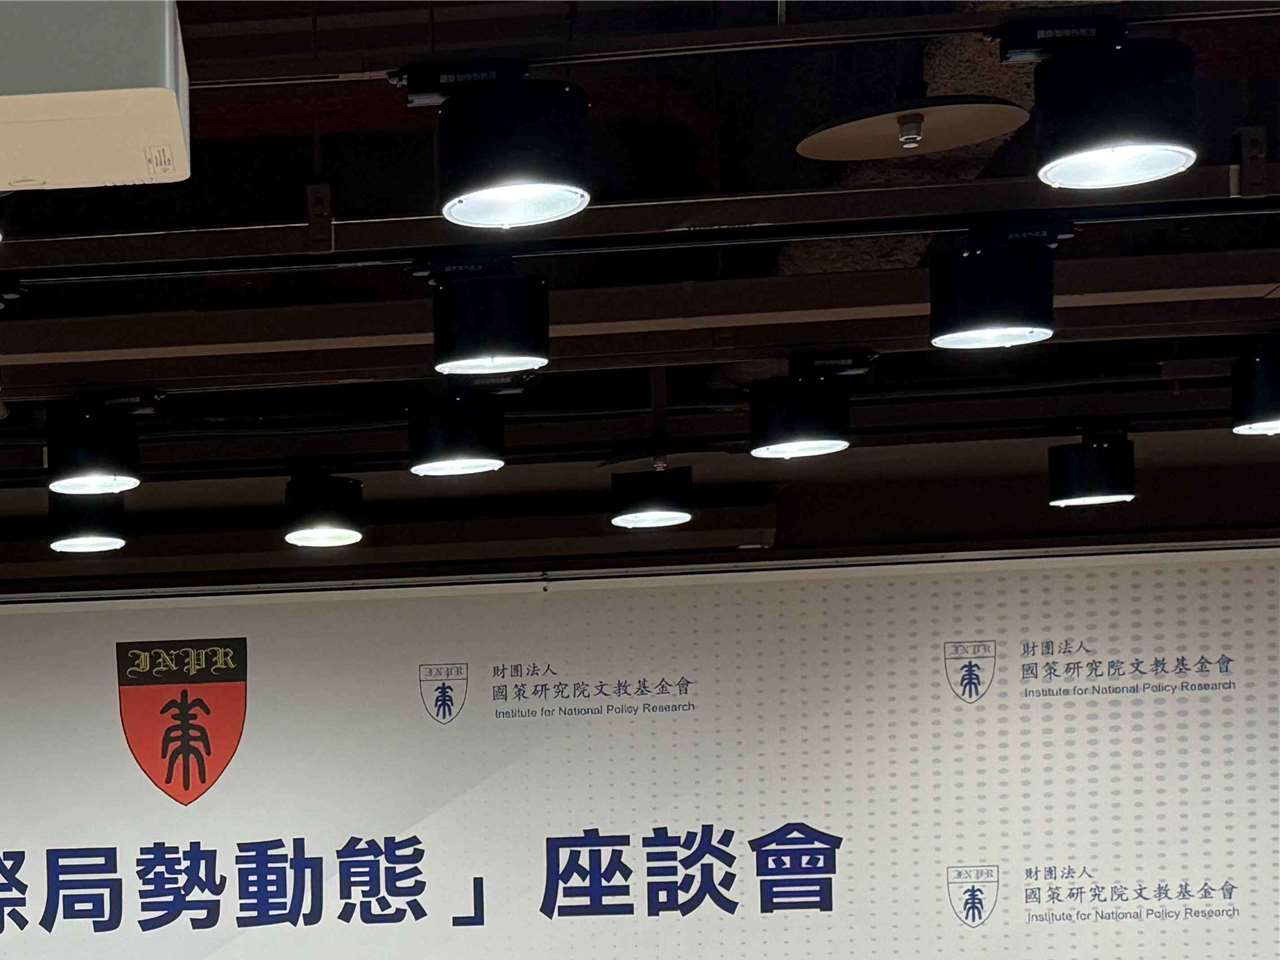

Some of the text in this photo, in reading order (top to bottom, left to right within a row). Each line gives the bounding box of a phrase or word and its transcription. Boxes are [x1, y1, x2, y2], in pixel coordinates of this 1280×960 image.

[1022, 640, 1091, 656] 財團法人
[493, 663, 558, 679] 財團法人
[1022, 654, 1234, 680] 國策研究院文教基金會
[492, 676, 696, 701] 國策研究院文教基金會
[1024, 680, 1236, 697] Institute for National Policy Research
[495, 702, 695, 718] Institute for National Policy Research
[1025, 865, 1094, 881] 財團法人
[1025, 880, 1238, 904] 國策研究院文教基金會
[1027, 907, 1240, 922] Institute for National Policy Research
